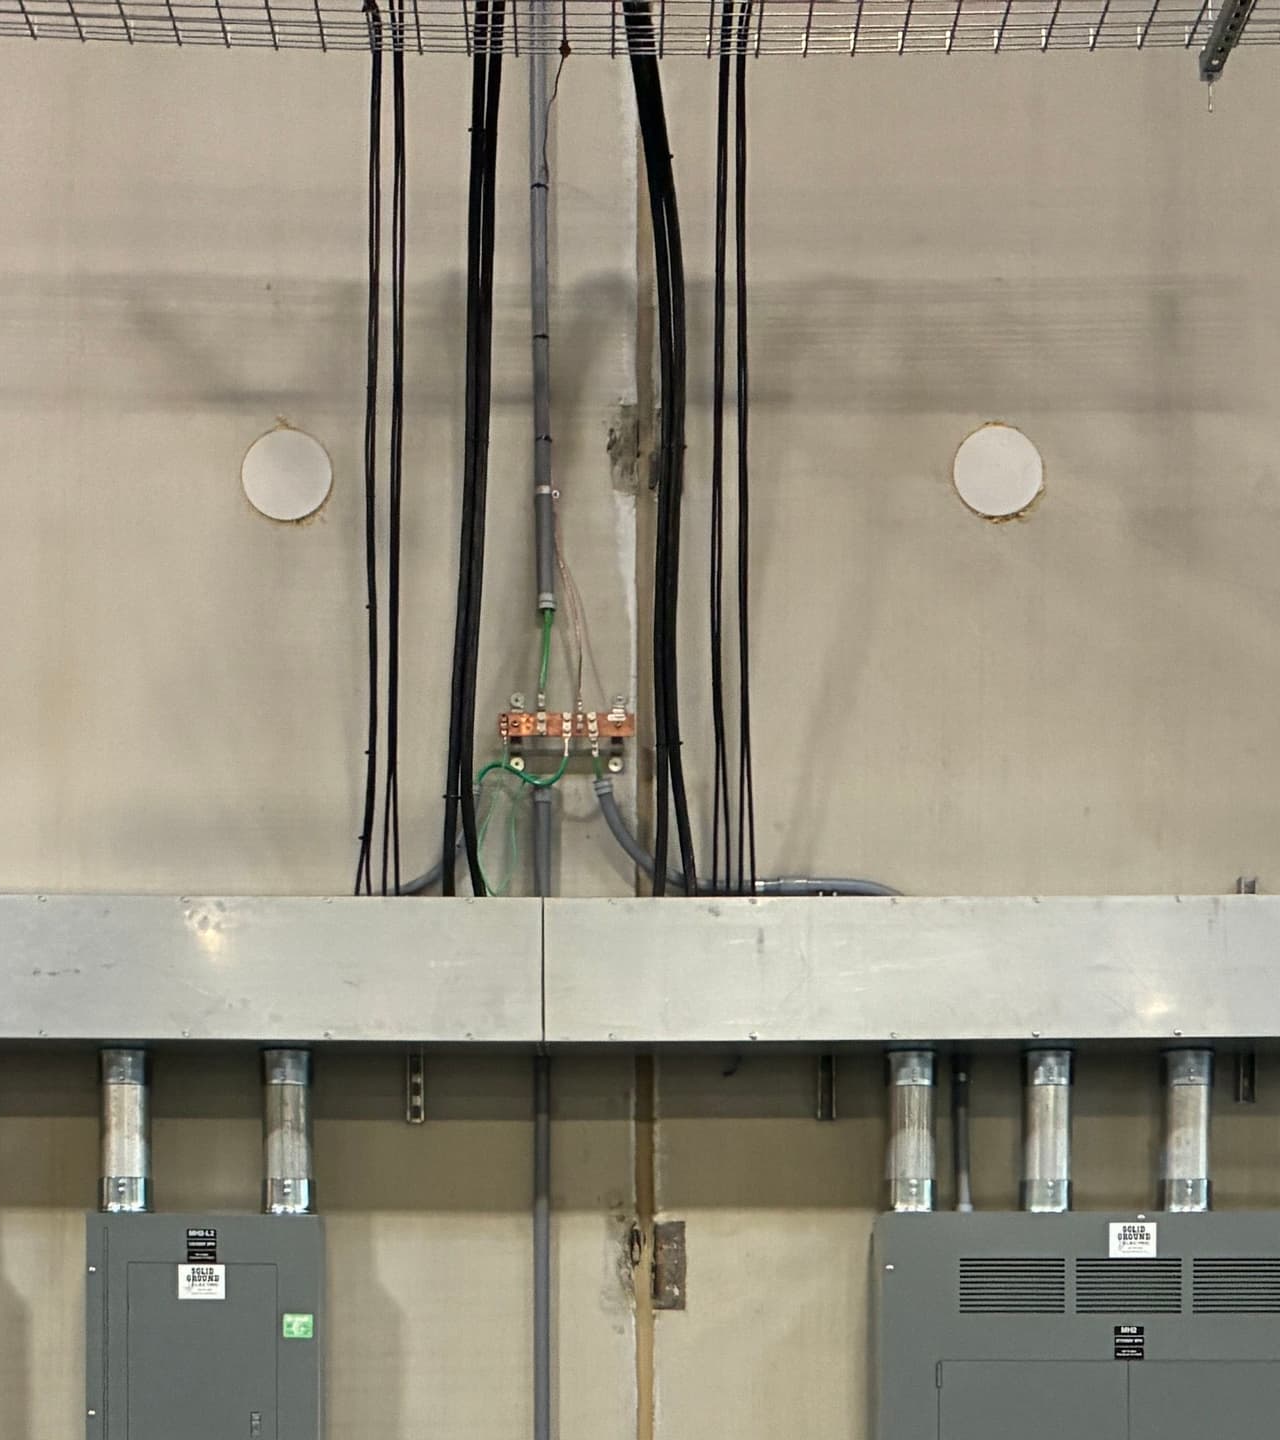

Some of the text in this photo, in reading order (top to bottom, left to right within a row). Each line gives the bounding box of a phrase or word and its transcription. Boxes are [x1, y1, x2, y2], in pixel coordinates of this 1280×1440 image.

[1122, 1225, 1146, 1233] SOLID
[1117, 1233, 1151, 1241] GROUND
[191, 1267, 214, 1275] SOLID
[186, 1274, 220, 1282] GROUND
